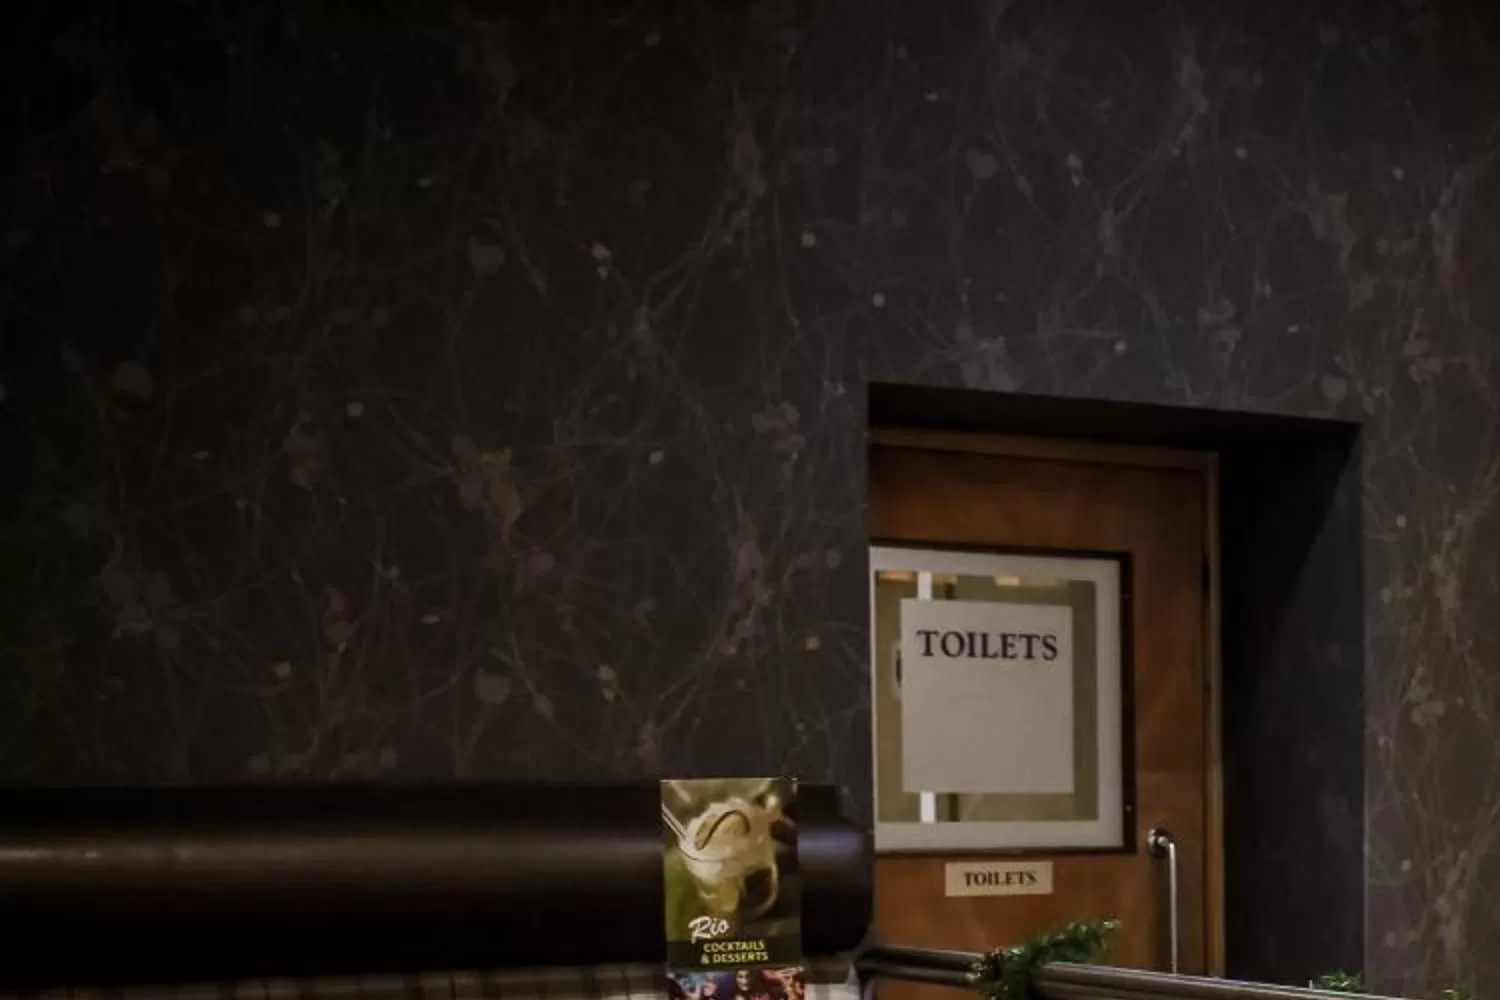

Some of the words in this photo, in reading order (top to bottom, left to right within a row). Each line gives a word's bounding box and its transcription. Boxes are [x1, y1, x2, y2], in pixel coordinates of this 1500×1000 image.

[916, 629, 1058, 661] TOILETS
[963, 870, 1038, 887] TOILETS
[688, 915, 730, 944] Rio
[703, 940, 765, 953] COCKTAILS
[712, 951, 769, 963] DESSERTS
